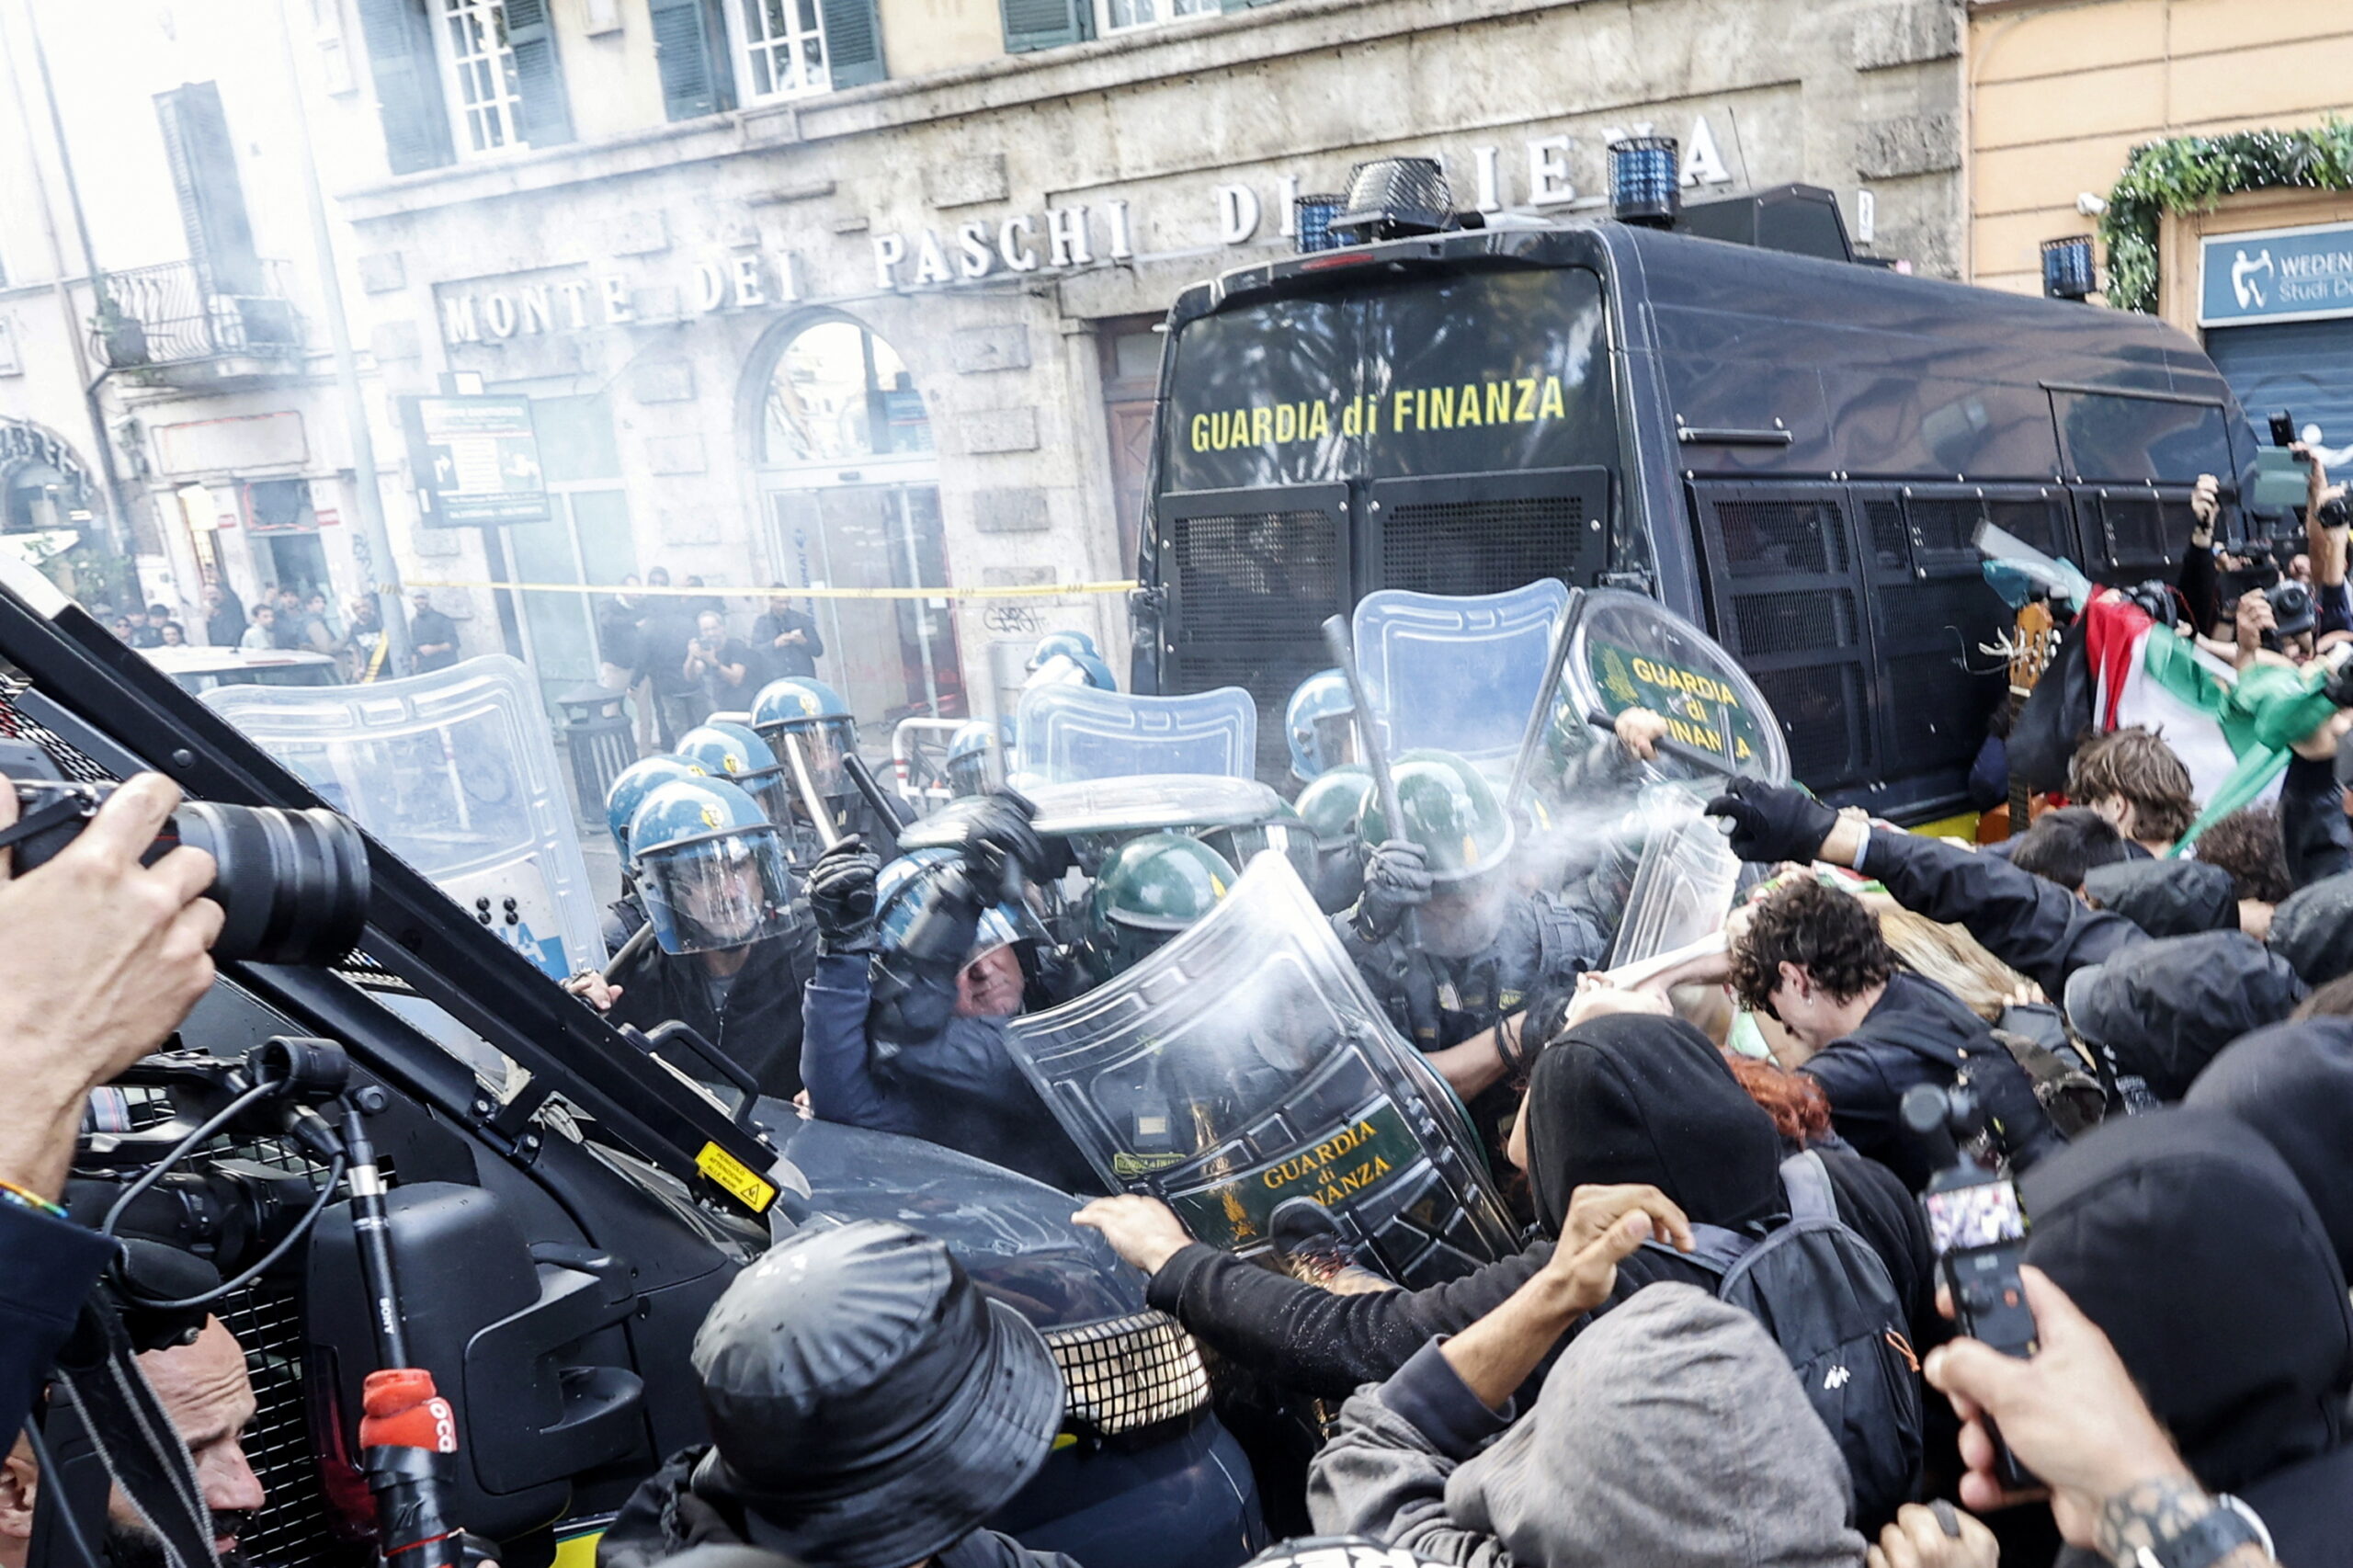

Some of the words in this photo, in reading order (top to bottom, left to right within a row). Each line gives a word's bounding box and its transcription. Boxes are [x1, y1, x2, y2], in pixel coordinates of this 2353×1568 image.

[444, 275, 636, 344] MONTE
[693, 249, 801, 313] DEI
[871, 199, 1134, 289] PASCHI
[1215, 173, 1299, 244] DI
[1437, 115, 1733, 213] IEA
[1190, 398, 1329, 453] GUARDIA
[1342, 394, 1378, 437] di
[1392, 375, 1566, 433] FINANZA
[1632, 657, 1740, 710] GUARDIA
[1665, 716, 1752, 760] INANA
[1685, 699, 1709, 724] di
[1263, 1119, 1378, 1189] GUARDIA
[1308, 1154, 1392, 1207] NANZA
[1317, 1165, 1337, 1186] di
[379, 1297, 395, 1335] SONY
